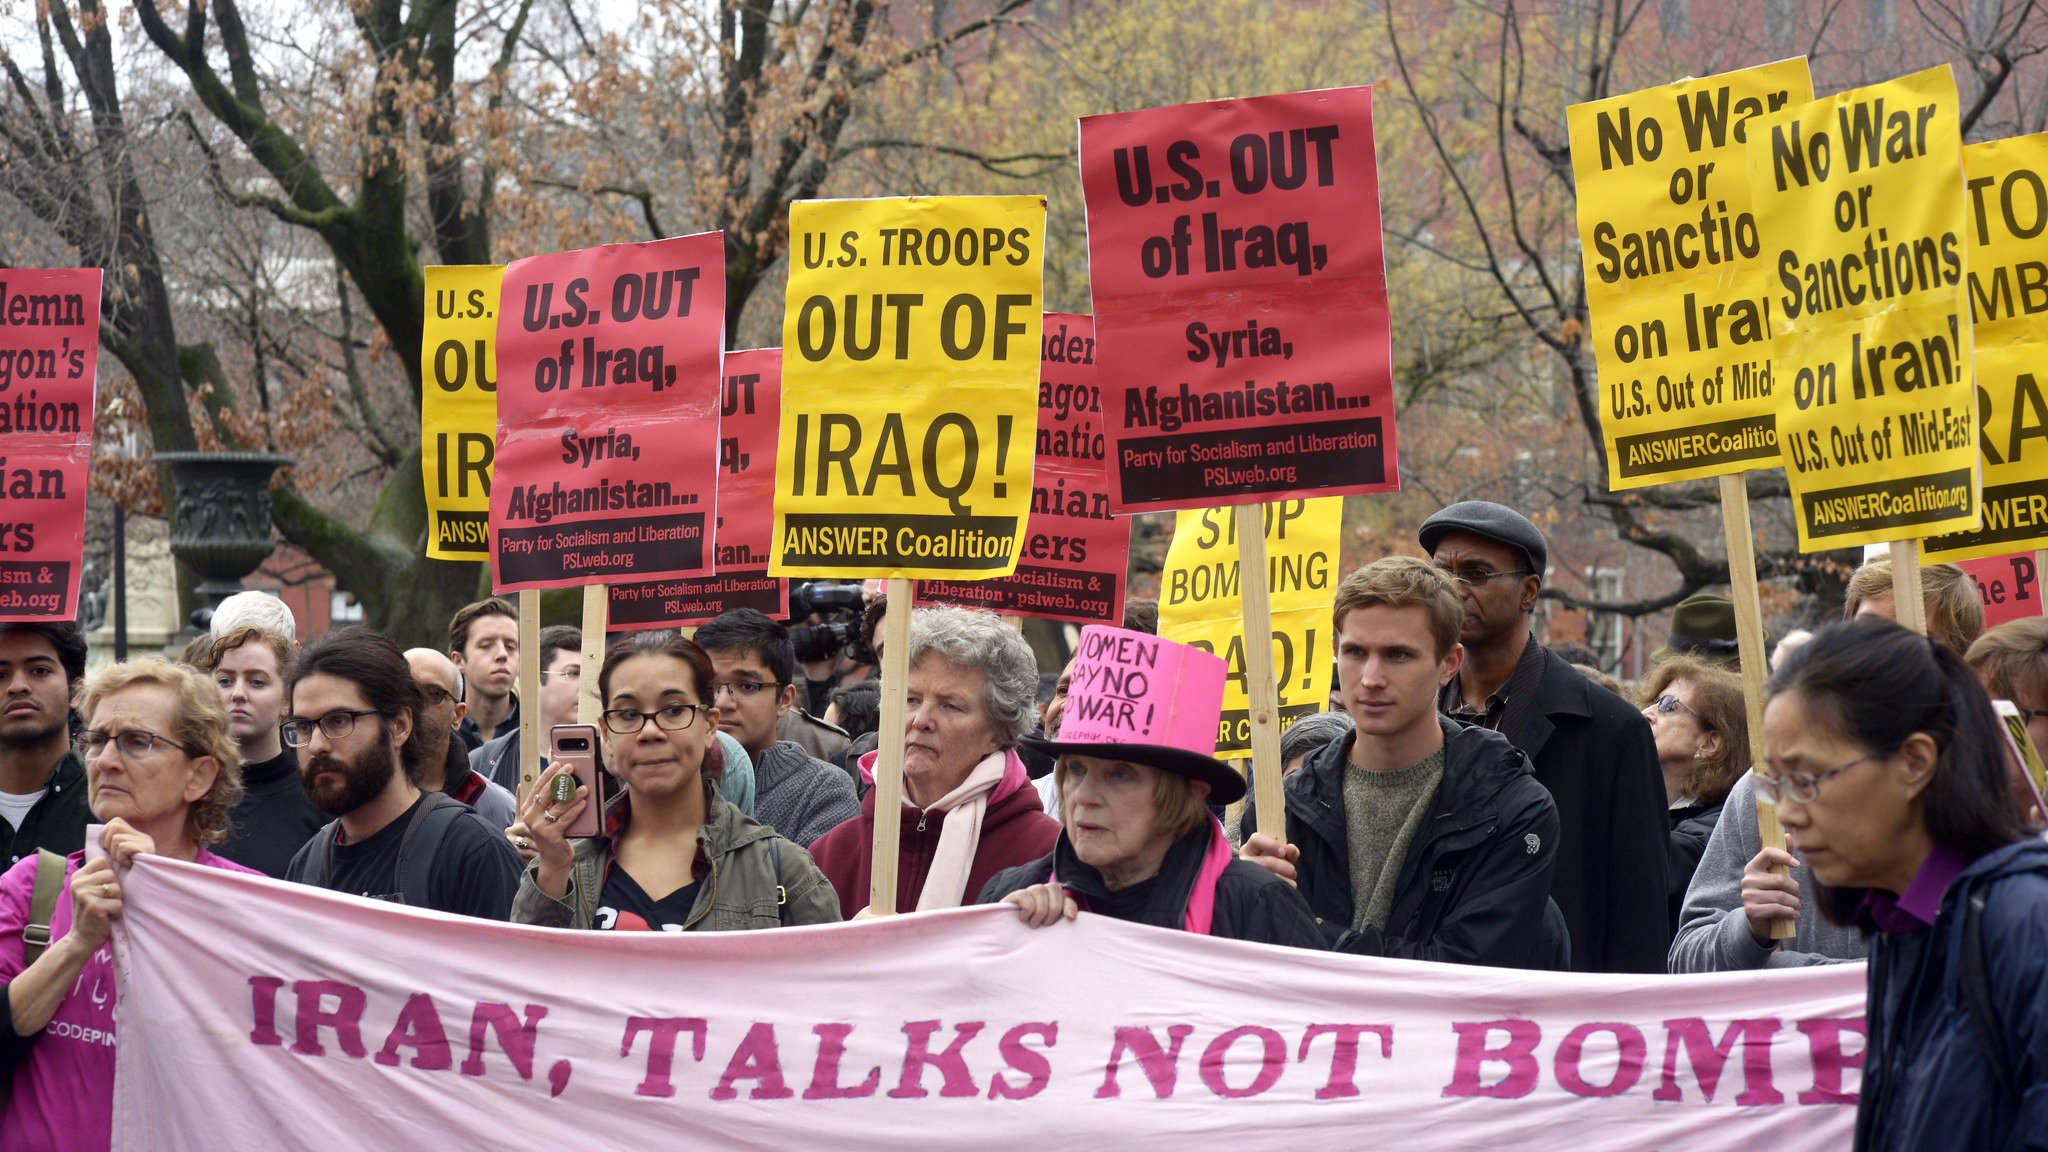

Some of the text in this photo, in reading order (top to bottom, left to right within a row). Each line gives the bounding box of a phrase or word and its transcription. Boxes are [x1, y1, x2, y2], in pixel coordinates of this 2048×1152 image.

[1597, 86, 1788, 171] No War
[1772, 97, 1937, 192] No War
[1113, 125, 1340, 206] U.S. OUT
[1669, 162, 1715, 205] or
[1834, 184, 1872, 233] or
[803, 227, 1030, 270] U.S. TROOPS
[1141, 212, 1328, 278] of Iraq,
[1594, 200, 1761, 283] Sanctio
[1778, 227, 1961, 320] Sanctions
[436, 289, 493, 319] U.S.
[522, 266, 700, 332] U.S. OUT
[797, 293, 1033, 362] OUT OF
[1185, 319, 1293, 368] Syria,
[1614, 319, 1668, 363] on
[534, 336, 677, 393] of Iraq,
[1794, 314, 1961, 410] on Iran!
[1124, 380, 1370, 431] Afghanistan...
[1611, 379, 1651, 420] U.S.
[1656, 372, 1695, 413] Out
[1702, 366, 1723, 406] of
[561, 427, 640, 468] Syria,
[1124, 432, 1377, 470] Party for Socialism and Liberation
[1788, 405, 1971, 473] U.S. Out of Mid-East
[437, 432, 495, 497] IR
[791, 412, 1013, 516] IRAQ!
[1204, 464, 1297, 487] PSLweb.org
[505, 478, 698, 523] Afghanistan...
[1814, 485, 1967, 526] ANSWERCoalition.org
[502, 525, 699, 554] Party for Socialism and Liberation
[562, 550, 634, 570] PSLweb.org
[783, 527, 1014, 557] ANSWER Coalition
[37, 567, 53, 583] &
[612, 577, 776, 601] Party for Socialism and Liberation
[923, 580, 1109, 616] Liberation pslweb.org
[1087, 576, 1101, 592] &
[1169, 551, 1328, 605] BOMING
[665, 600, 723, 614] PSLweb.org
[1101, 666, 1149, 699] NO
[247, 976, 572, 1098] IRAN,
[620, 1015, 1059, 1100] TALKS
[1093, 1022, 1394, 1100] NOT
